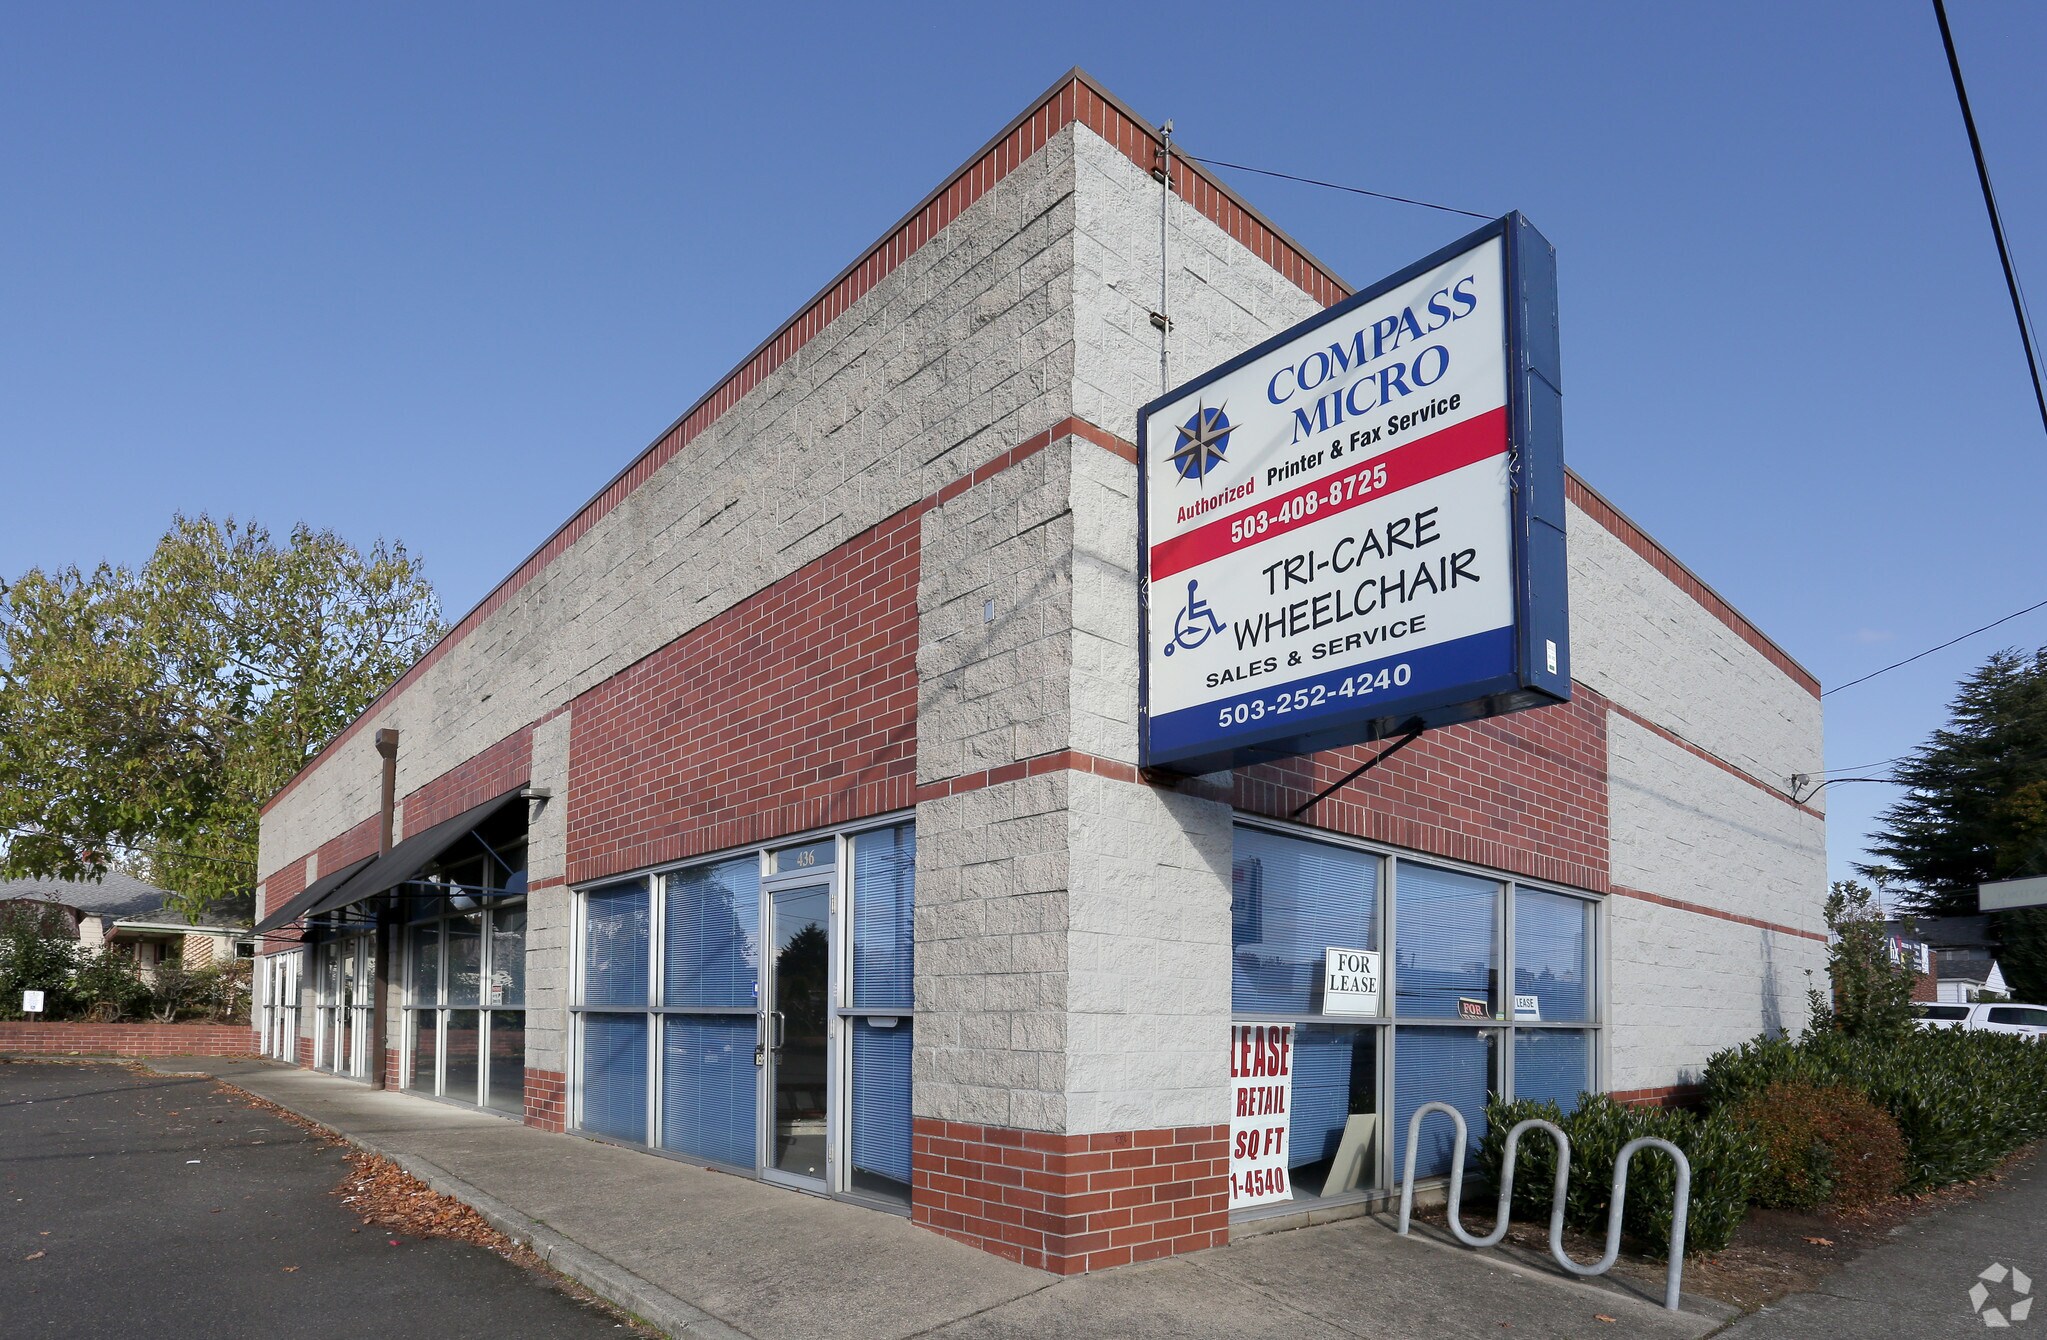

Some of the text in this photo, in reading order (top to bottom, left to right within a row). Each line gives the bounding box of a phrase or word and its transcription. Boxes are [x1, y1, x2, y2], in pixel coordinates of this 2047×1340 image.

[1267, 275, 1477, 405] COMPASS
[1290, 345, 1449, 445] MICRO
[1177, 393, 1461, 524] Authorized Printer & Fax Service
[1231, 463, 1388, 543] 503-408-8725
[1262, 506, 1441, 595] TRI-CARE
[1234, 548, 1480, 651] WHEELCHAIR
[1206, 614, 1427, 688] SALES & SERVICE
[1218, 663, 1412, 728] 503-252-4240
[797, 849, 815, 867] 436
[1330, 975, 1376, 993] LEASE
[1338, 953, 1370, 973] FOR
[1463, 1002, 1483, 1015] FOR
[1516, 998, 1534, 1008] LEASE
[1231, 1025, 1290, 1077] LEASE
[1236, 1086, 1285, 1117] RETAIL
[1234, 1127, 1285, 1160] SQ FT
[1230, 1166, 1285, 1200] 1-4540
